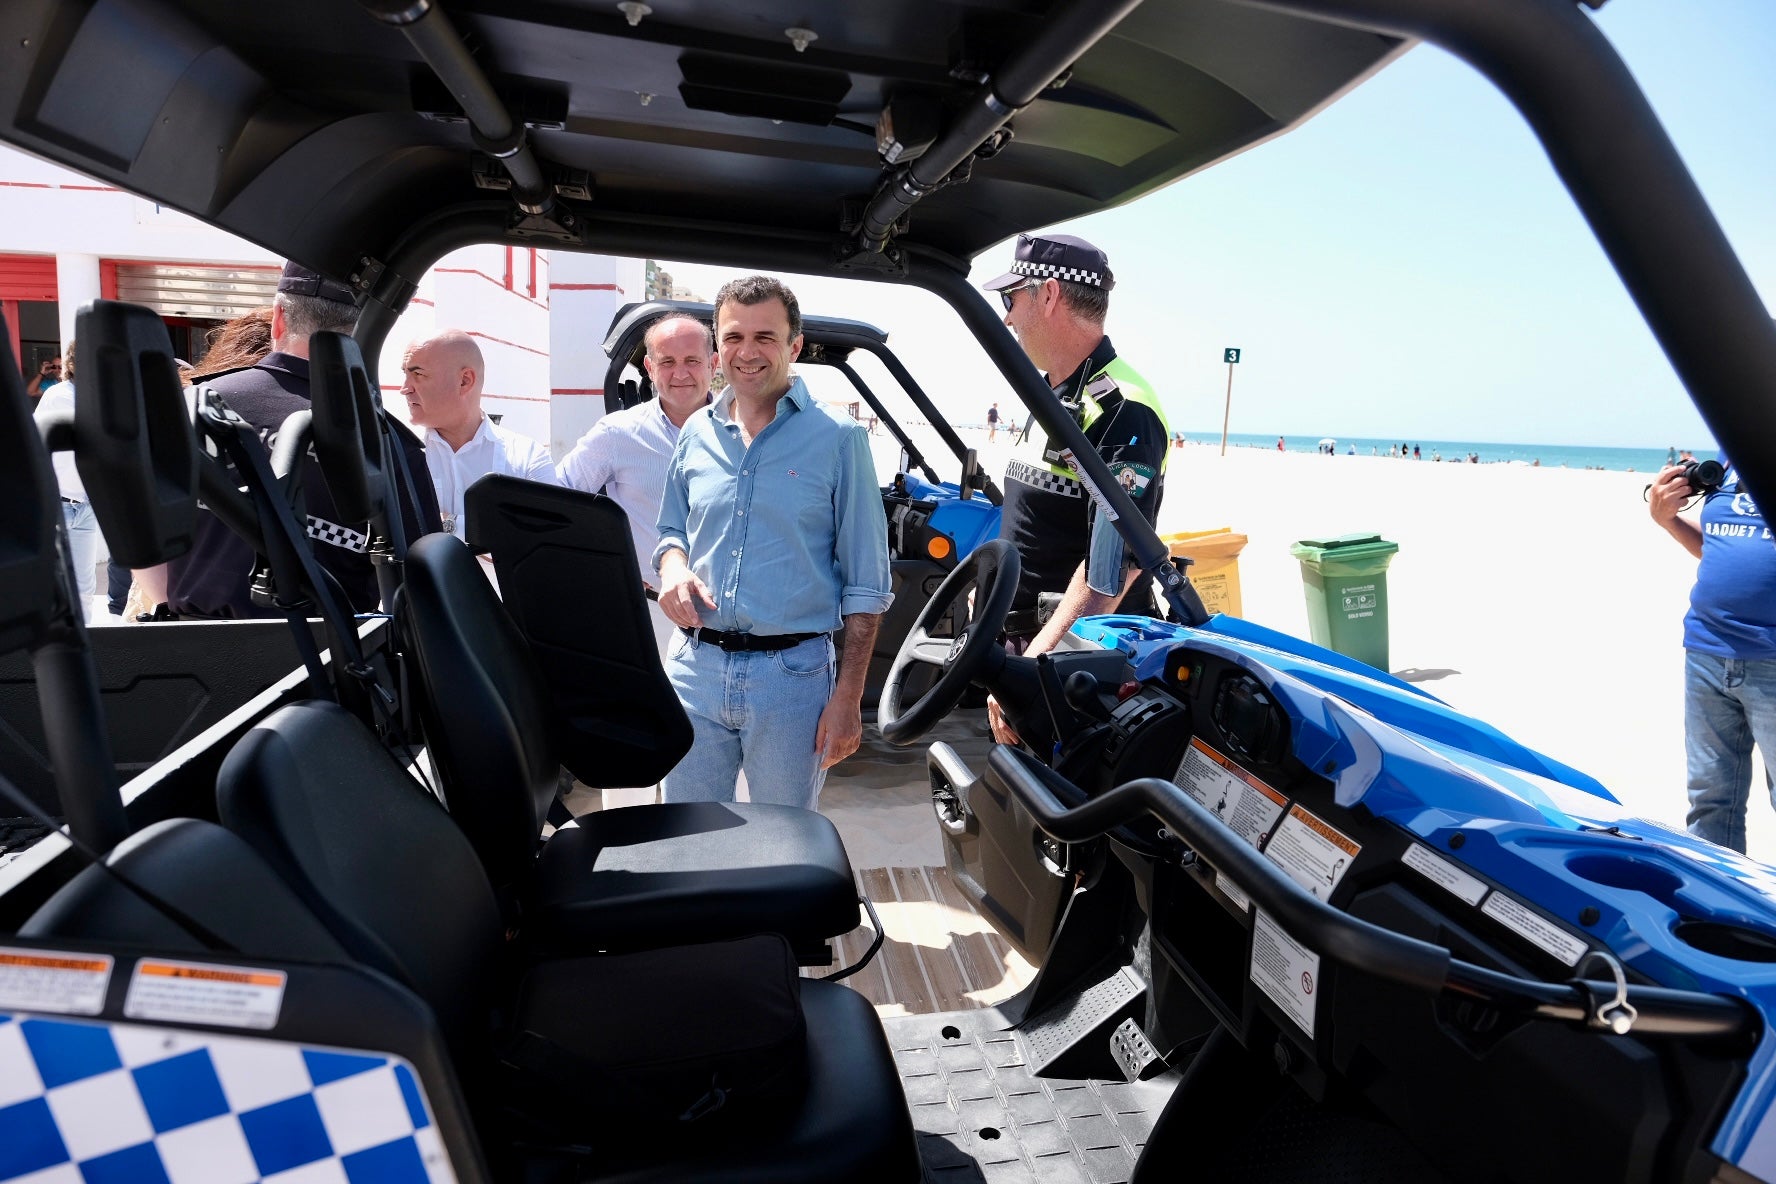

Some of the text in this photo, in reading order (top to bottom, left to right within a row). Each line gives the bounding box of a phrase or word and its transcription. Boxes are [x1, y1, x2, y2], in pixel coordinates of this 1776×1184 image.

[1229, 350, 1237, 362] 3
[1131, 463, 1151, 473] LOCAL
[1300, 813, 1357, 854] AVERTISSEMENT
